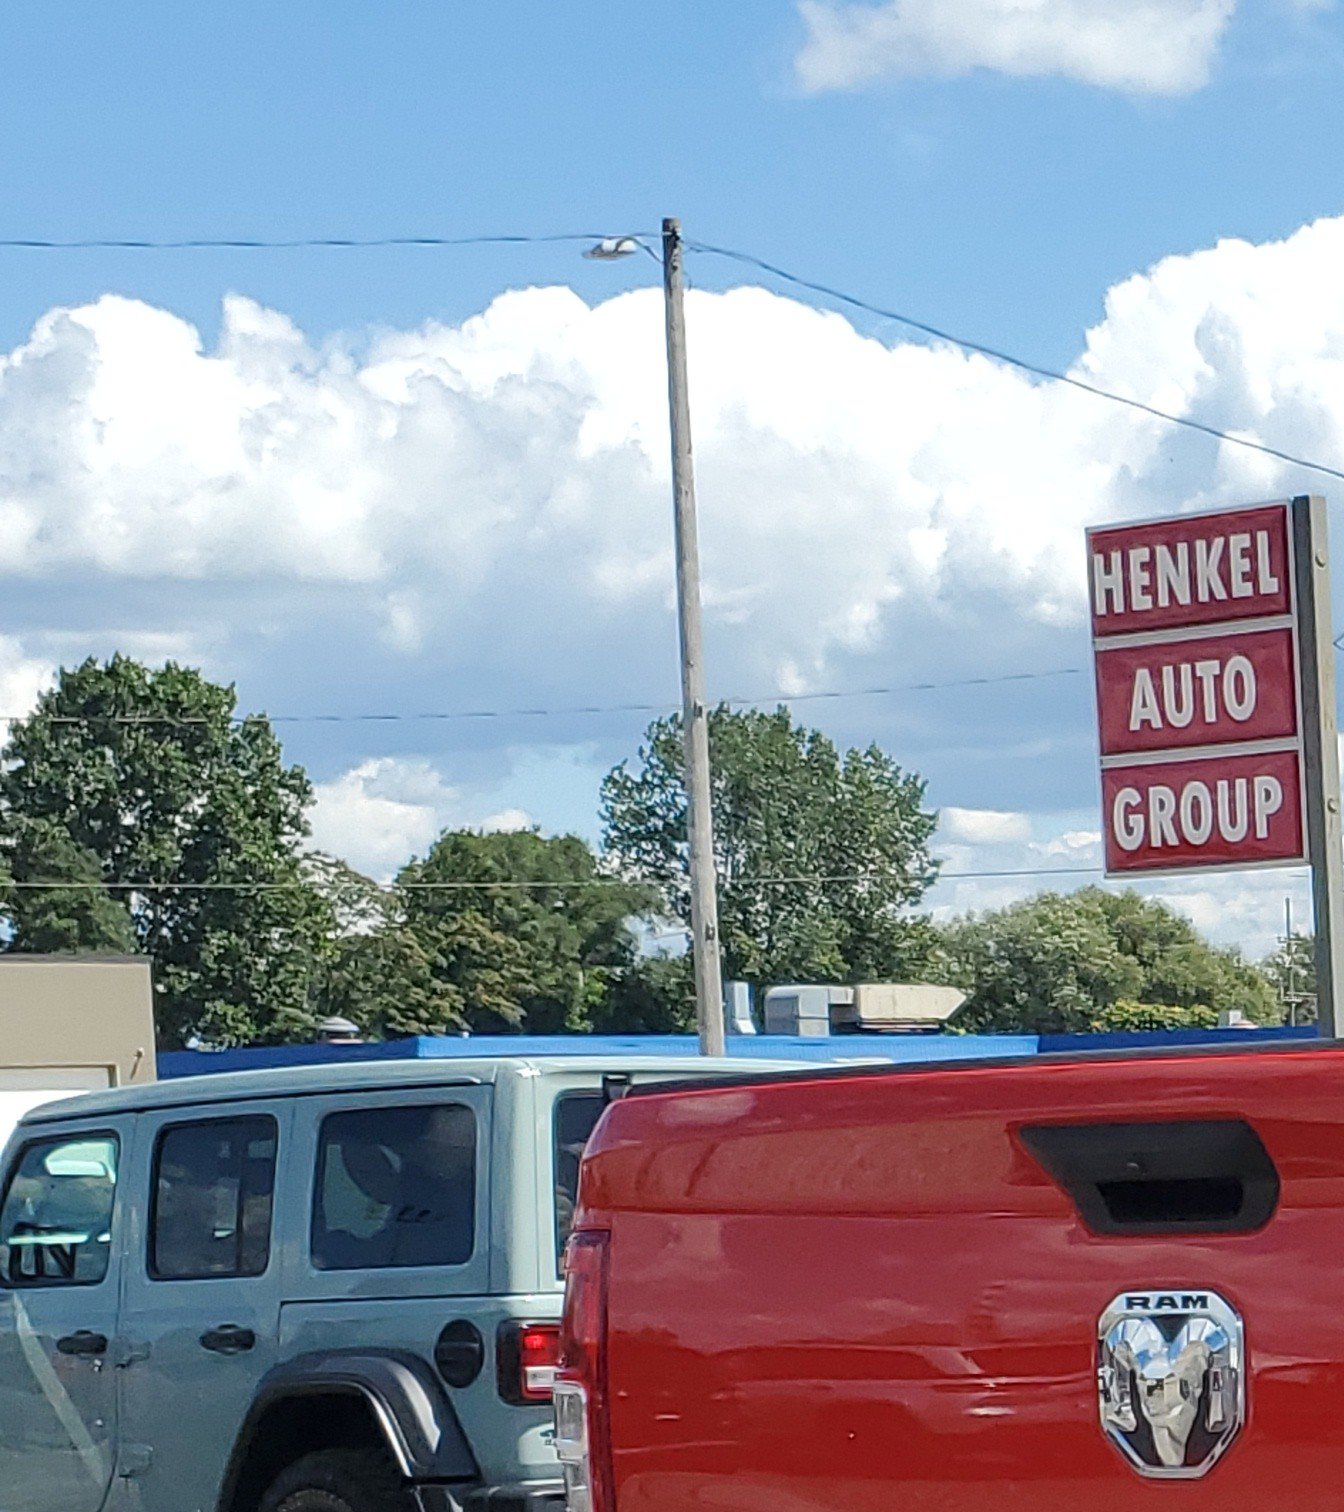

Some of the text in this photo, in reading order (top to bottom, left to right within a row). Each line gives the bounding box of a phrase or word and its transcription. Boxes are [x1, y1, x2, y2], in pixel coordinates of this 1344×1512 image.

[1092, 530, 1279, 616] HENKEL
[1129, 654, 1257, 732] AUTO
[1113, 774, 1283, 851] GROUP
[1125, 1295, 1209, 1311] RAM
